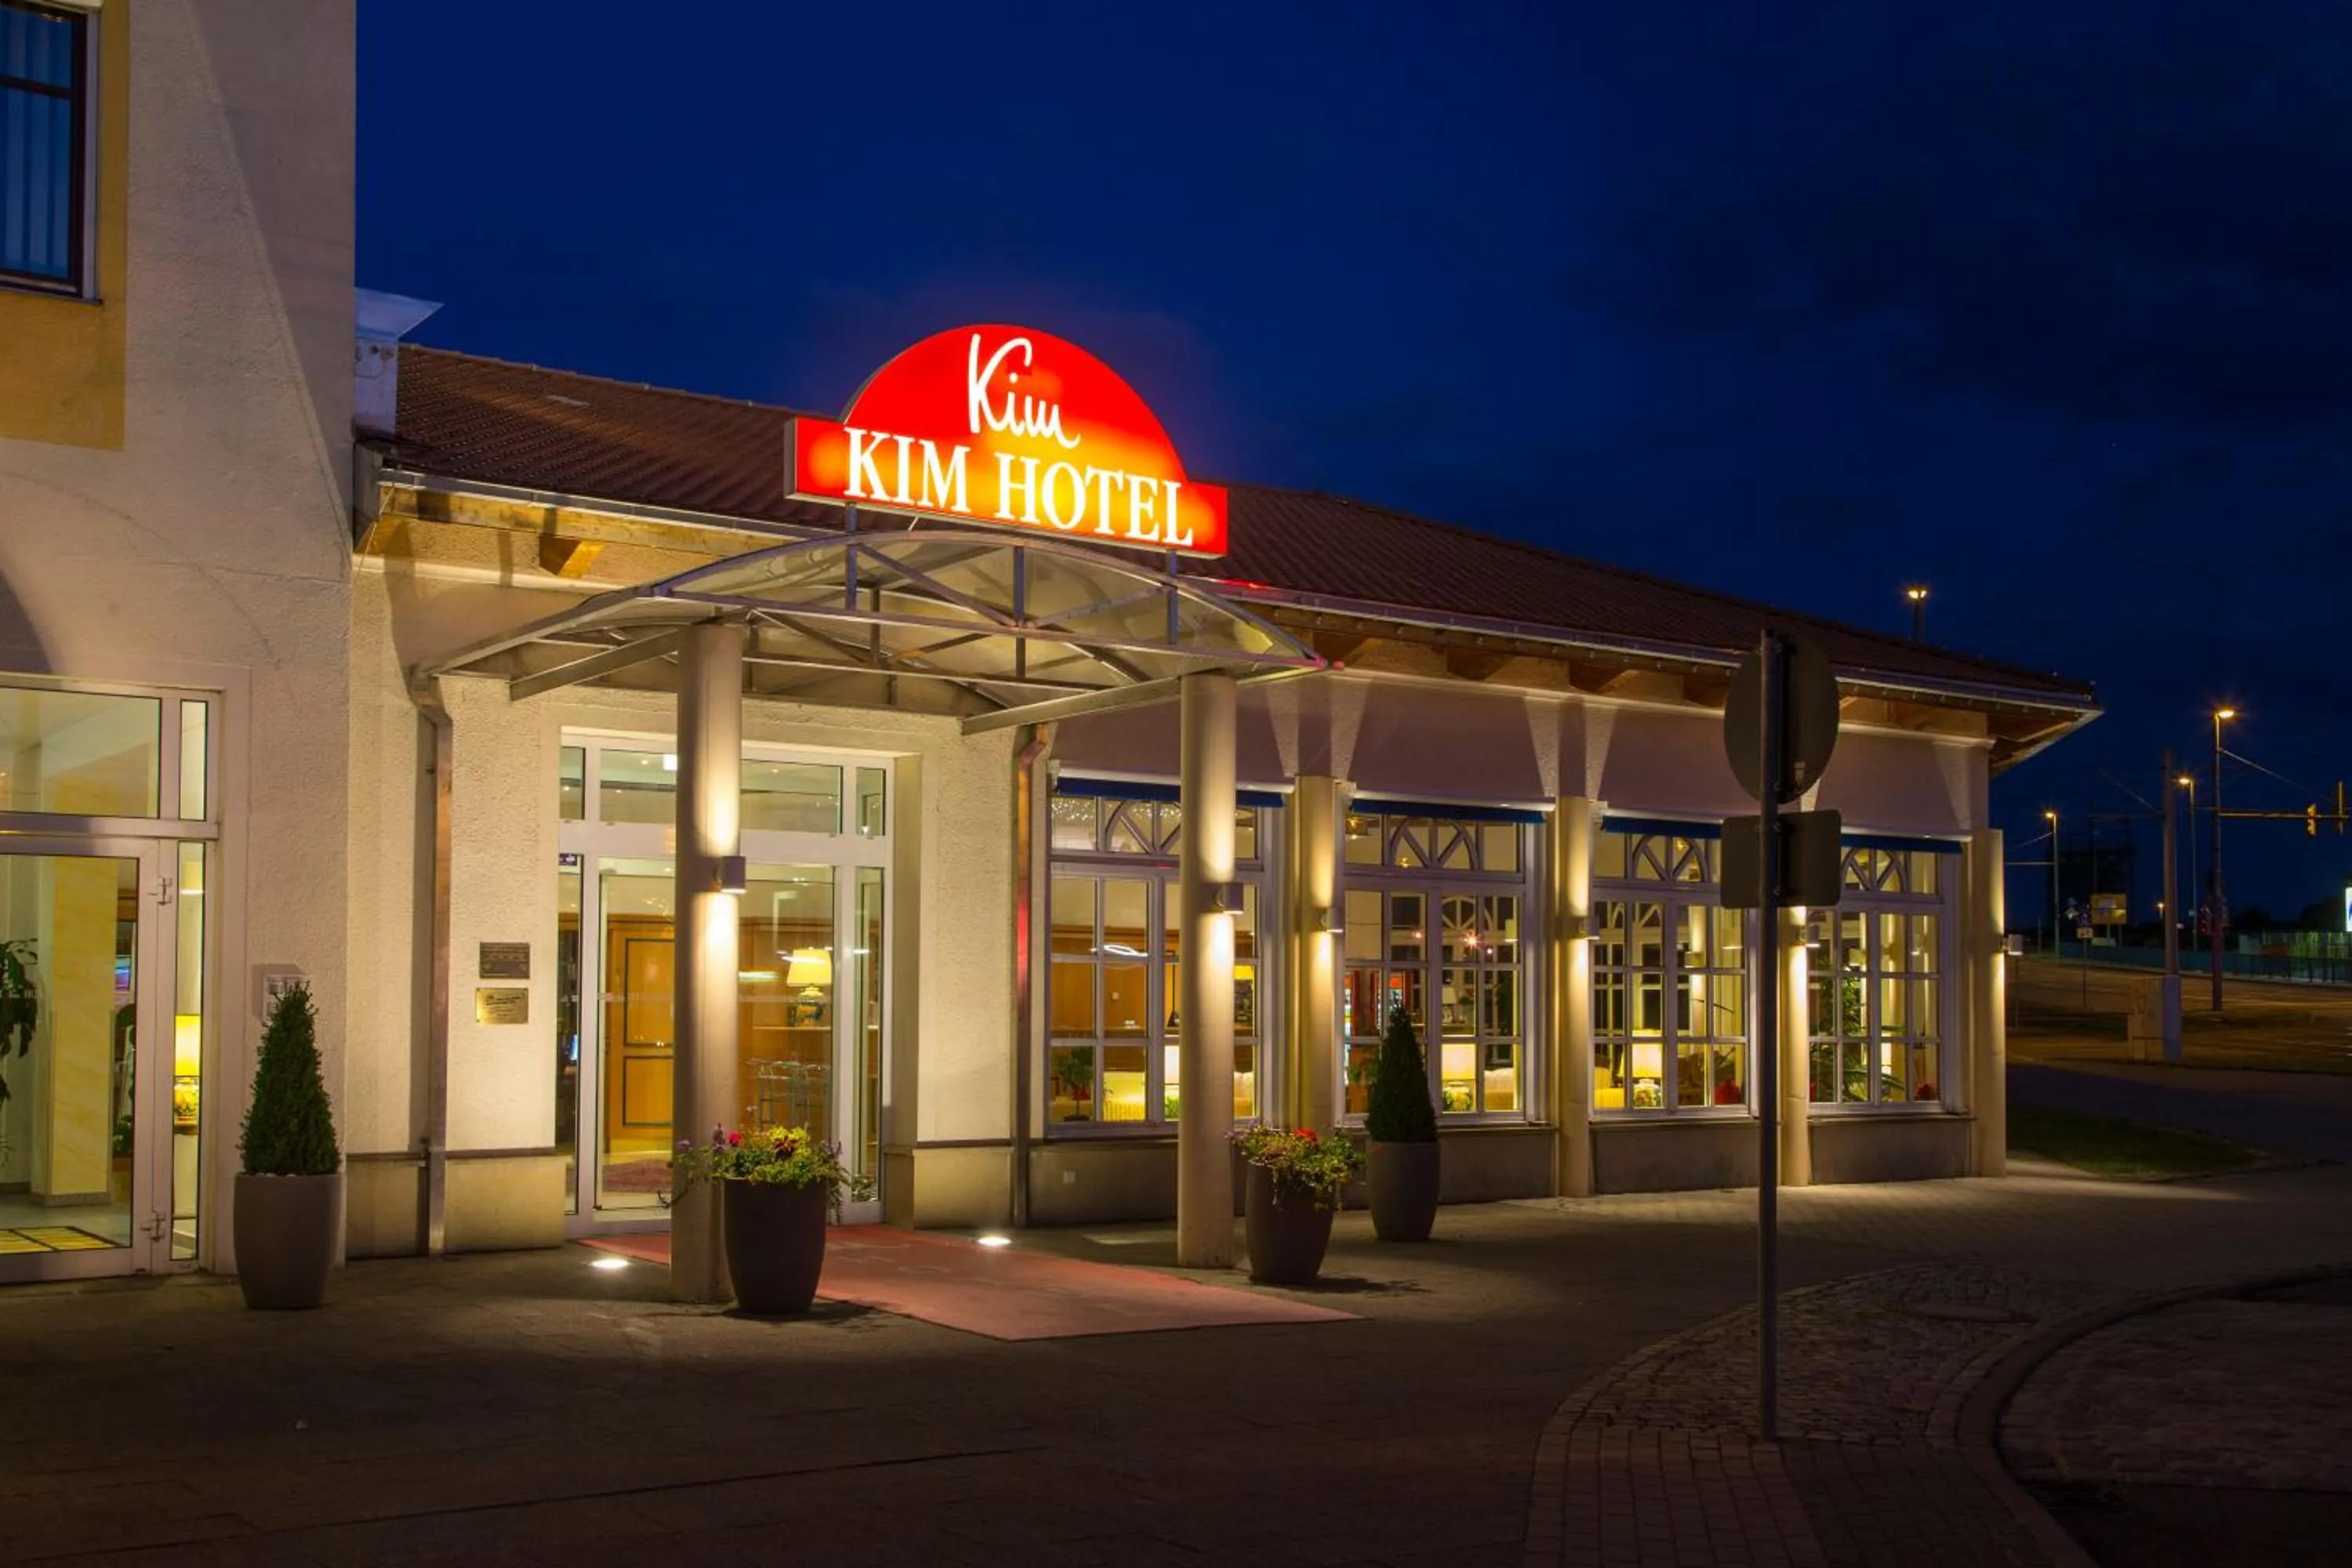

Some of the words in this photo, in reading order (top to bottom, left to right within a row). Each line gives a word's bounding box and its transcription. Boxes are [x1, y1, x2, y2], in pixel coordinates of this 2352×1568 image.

[967, 333, 1081, 449] Kim
[843, 426, 971, 514] KIM
[993, 452, 1193, 546] HOTEL
